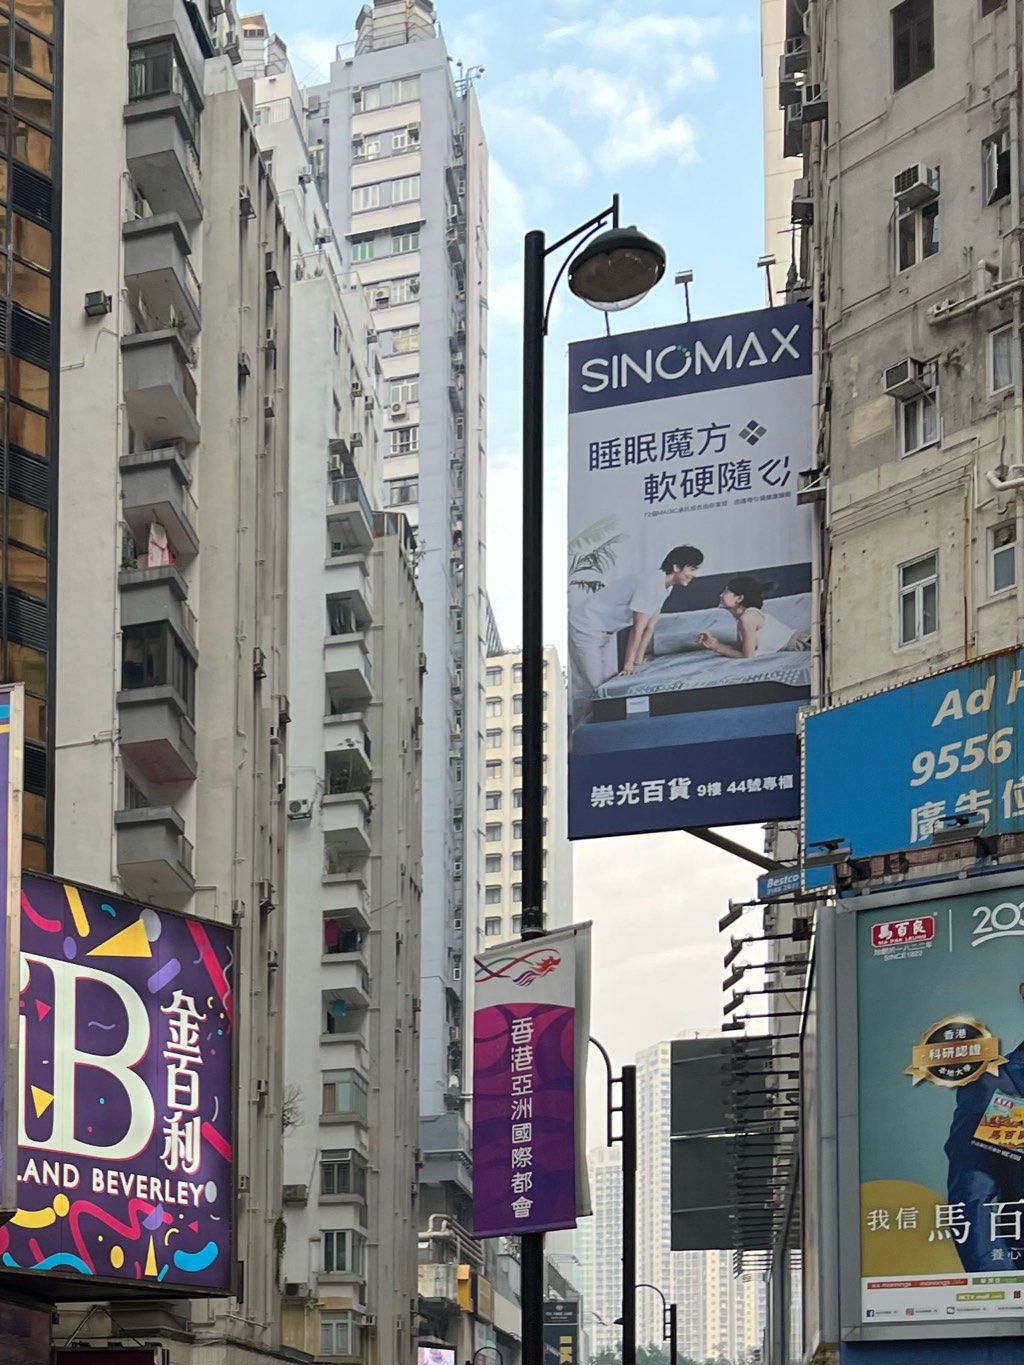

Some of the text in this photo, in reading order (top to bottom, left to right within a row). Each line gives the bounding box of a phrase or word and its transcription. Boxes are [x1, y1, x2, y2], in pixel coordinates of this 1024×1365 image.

[581, 324, 800, 392] SINOMAX
[588, 422, 731, 472] 睡眠魔方
[931, 675, 996, 727] Ad
[909, 727, 1014, 787] 9556
[590, 776, 692, 808] 崇光百貨
[878, 920, 926, 939] 馬百良
[928, 1044, 982, 1060] 科研認證
[943, 1028, 967, 1041] 香港
[160, 990, 206, 1176] 金百利
[511, 1016, 534, 1219] 香港亞洲國際都會
[17, 1158, 204, 1207] AND BEVERLEY
[867, 1207, 919, 1232] 我信
